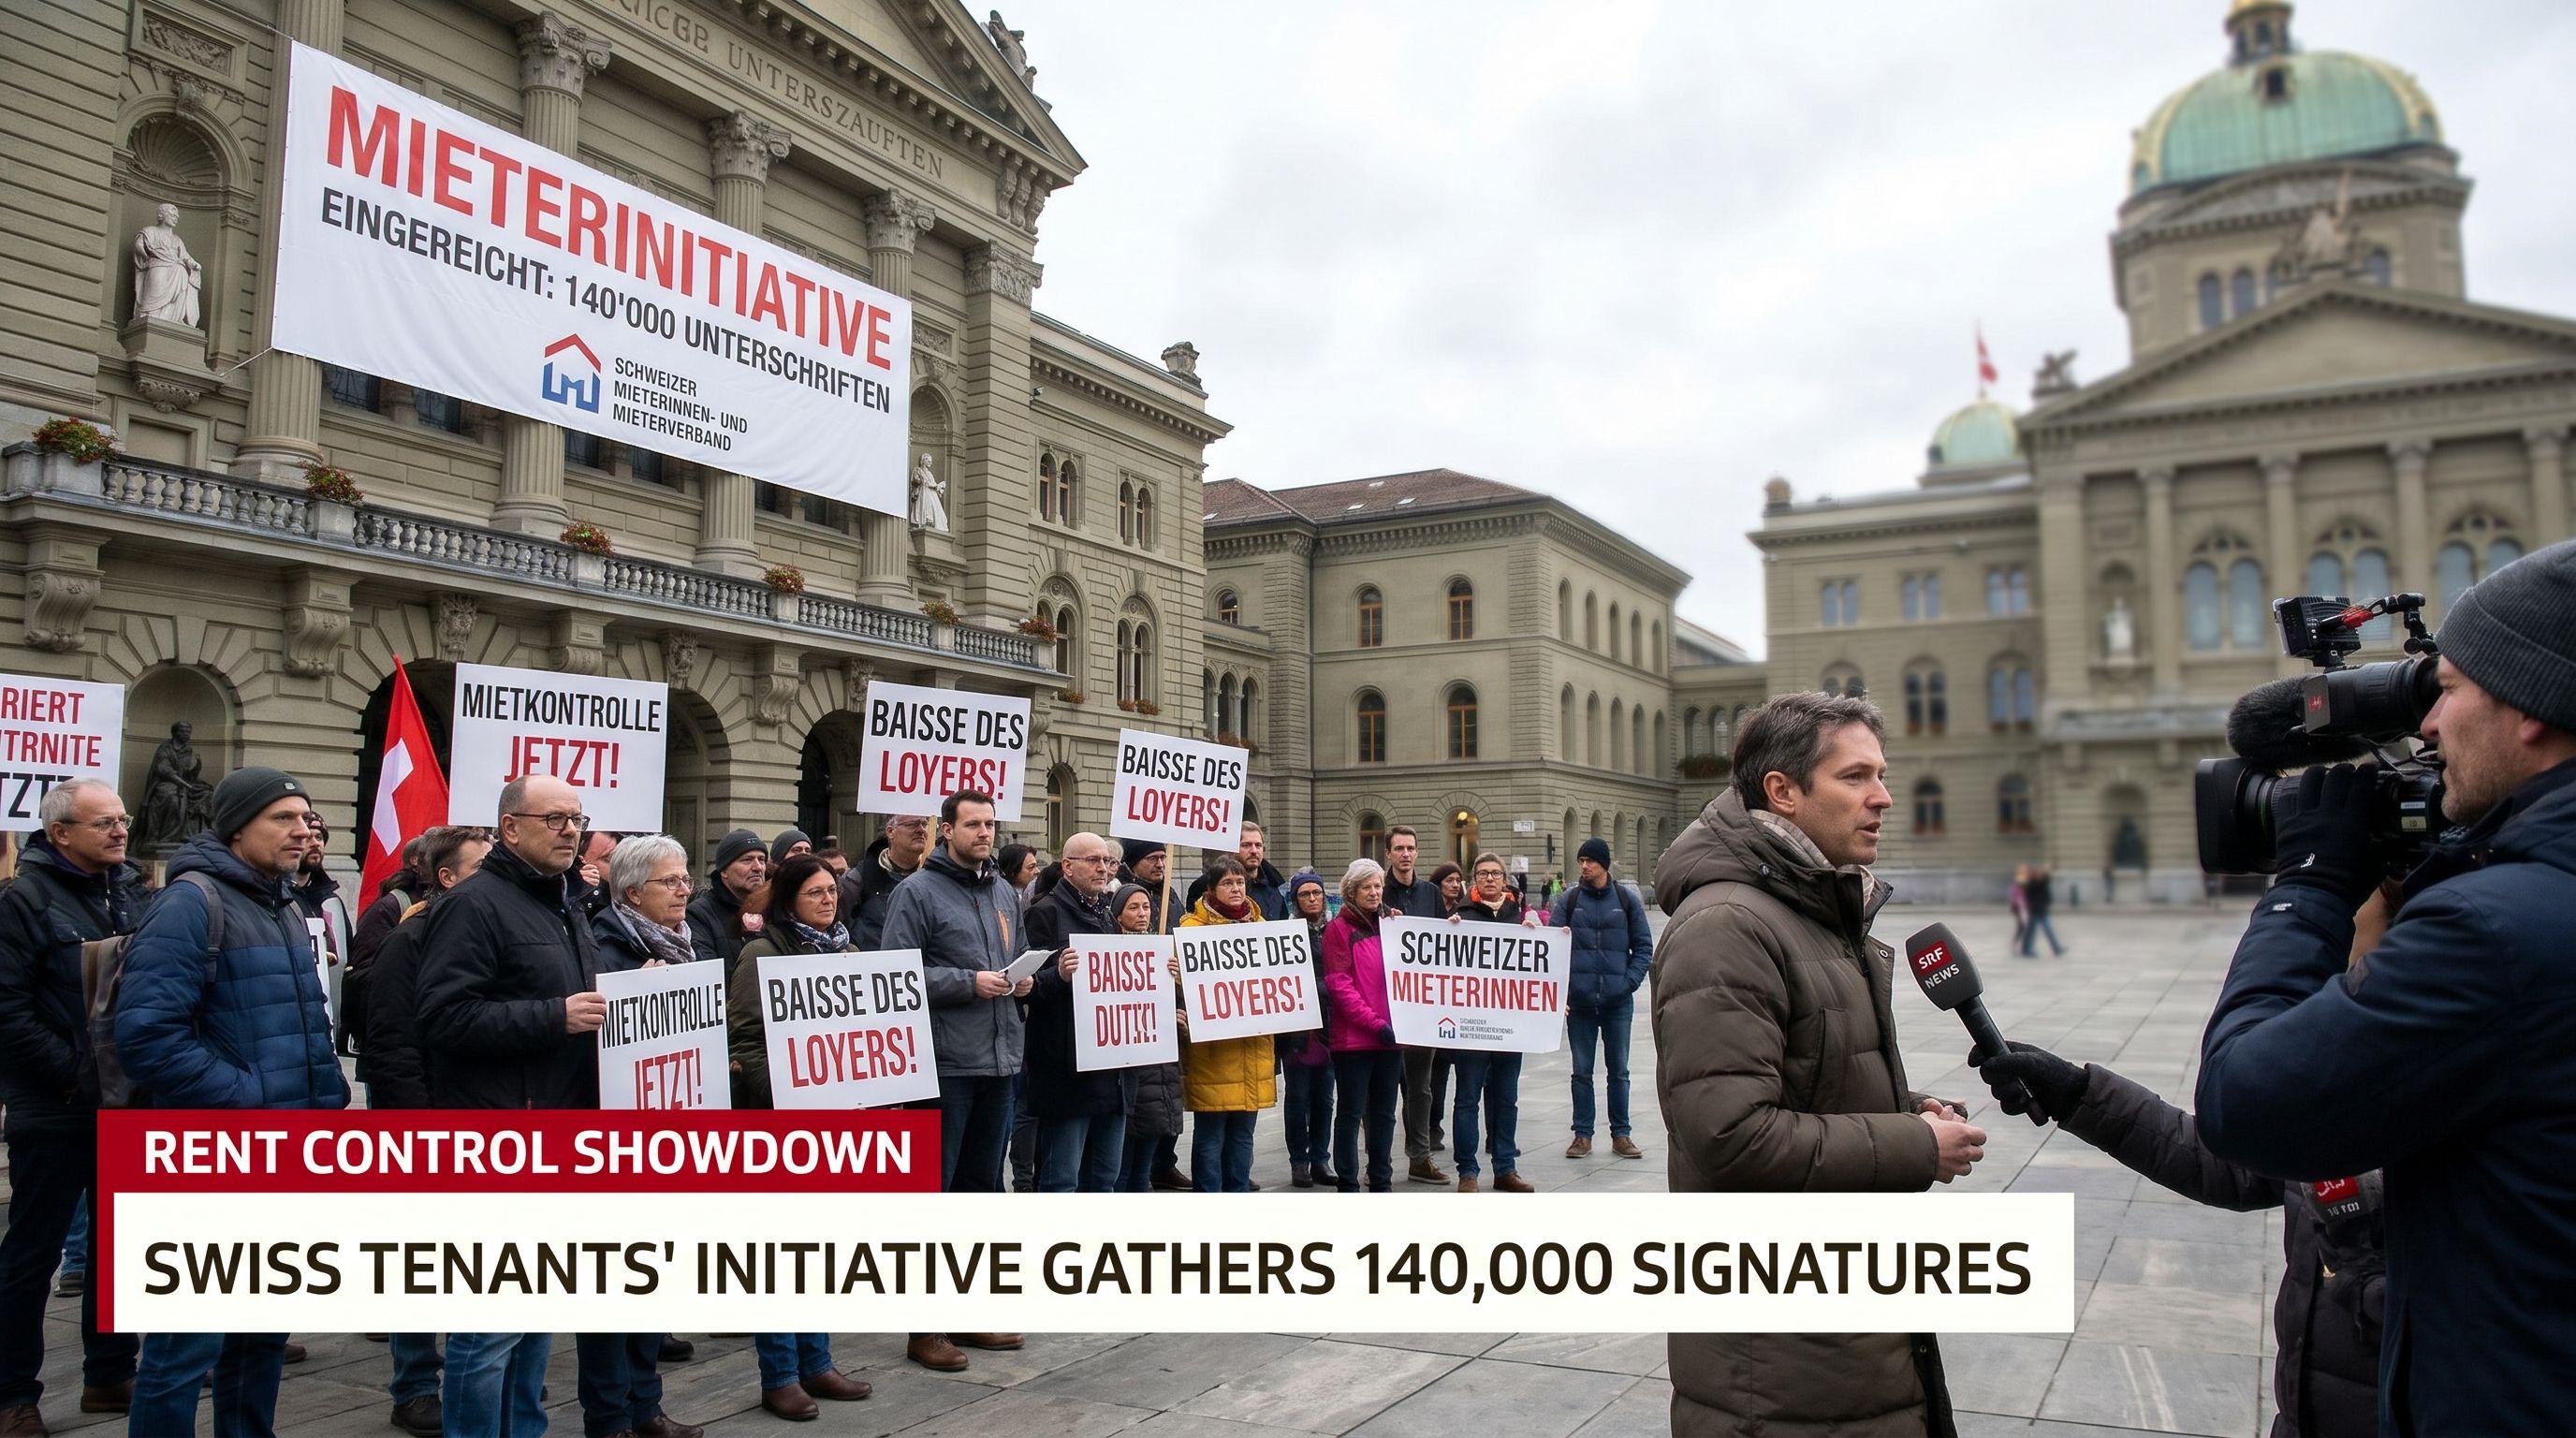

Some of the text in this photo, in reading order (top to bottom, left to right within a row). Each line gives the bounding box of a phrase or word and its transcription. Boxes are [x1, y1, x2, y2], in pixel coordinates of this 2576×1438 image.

[327, 85, 891, 371] MIETERINITIATIVE
[322, 186, 890, 414] EINGEREICHT: 140'000 UNTERSCHRIFTEN
[615, 357, 697, 397] SCHWEIZER
[613, 404, 731, 451] MIETERVERBAND
[614, 380, 747, 433] MIETERINNEN- UND
[462, 682, 661, 732] MIETKONTROLLE
[871, 699, 1024, 750] BAISSE DES
[0, 729, 102, 767] TRNITE
[504, 736, 619, 788] JETZT!
[1122, 744, 1241, 790] BAISSE DES
[880, 750, 1006, 800] LOYERS!
[1128, 785, 1230, 833] LOYERS!
[1088, 950, 1156, 992] BAISSE
[1182, 934, 1307, 973] BAISSE DES
[1400, 931, 1549, 973] SCHWEIZER
[1918, 946, 1943, 969] SRF
[768, 970, 922, 1022] BAISSE DES
[1198, 976, 1304, 1021] LOYERS!
[1392, 970, 1558, 1012] MIETERINNEN
[1925, 963, 1960, 990] NEWS
[602, 983, 724, 1049] MIETKONTROLLE
[787, 1026, 917, 1088] LOYERS!
